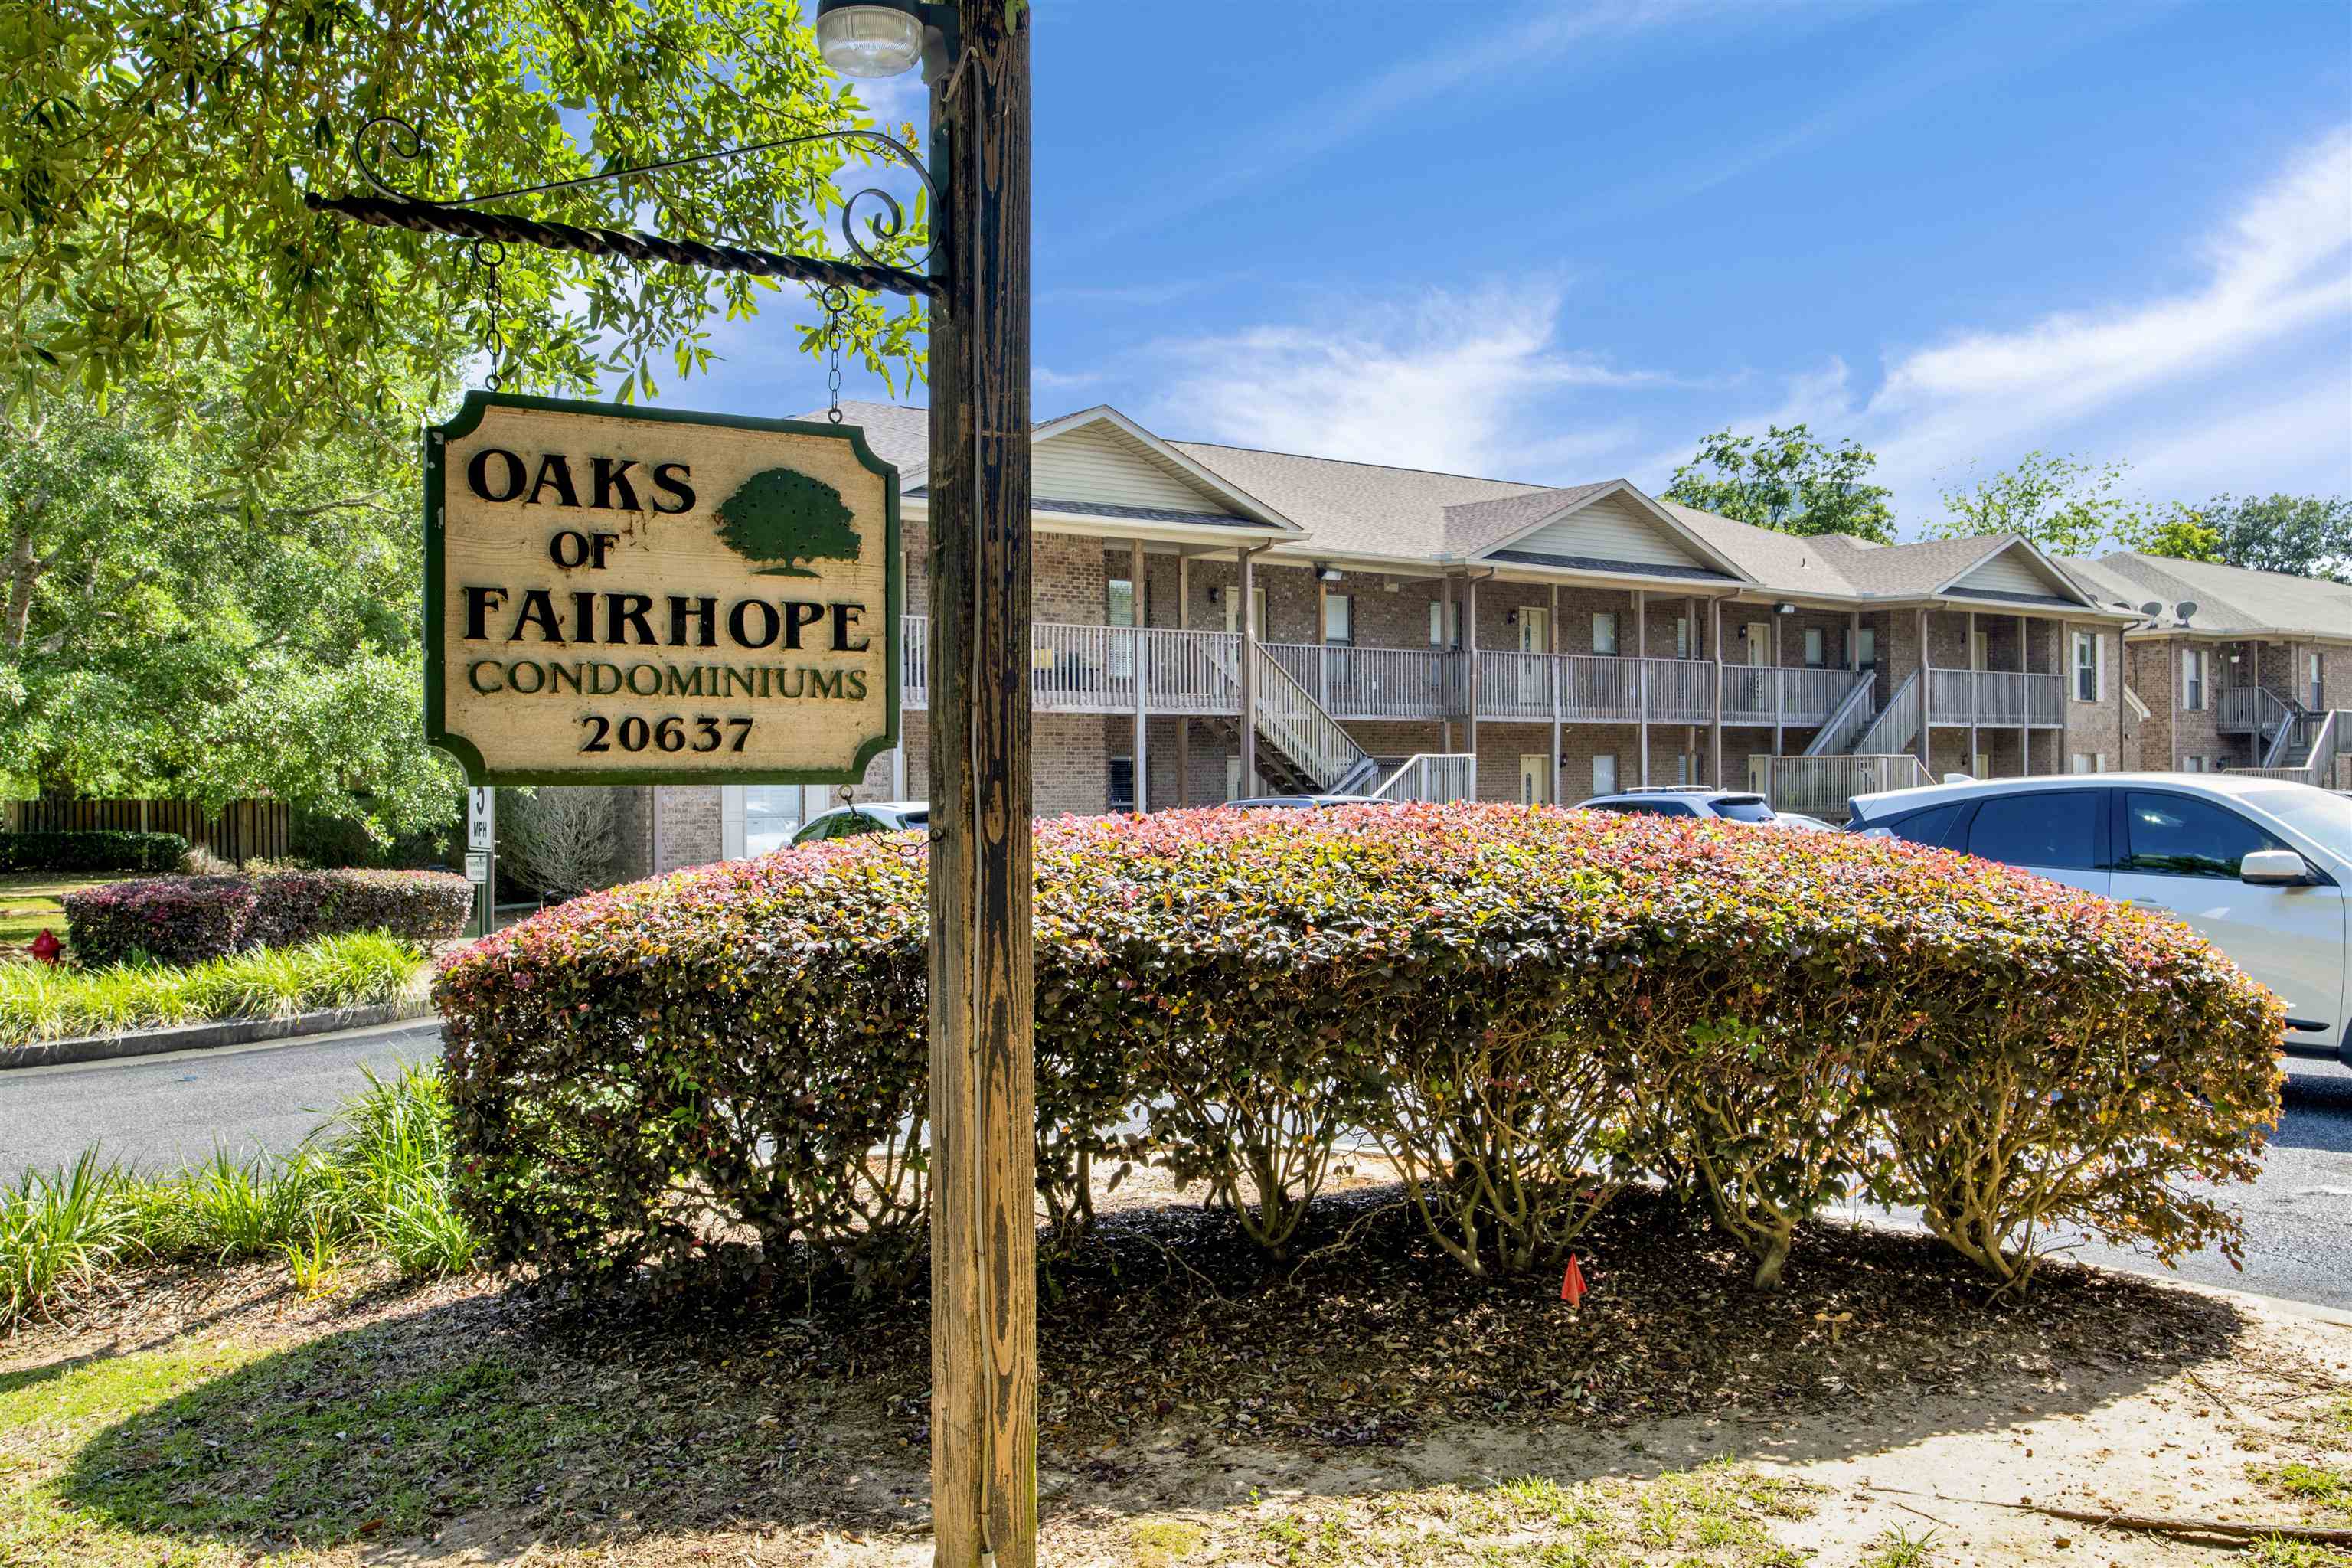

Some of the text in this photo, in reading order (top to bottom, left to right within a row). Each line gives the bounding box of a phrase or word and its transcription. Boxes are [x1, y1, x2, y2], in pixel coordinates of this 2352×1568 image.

[467, 449, 697, 514] OAKS
[550, 531, 620, 570] OF
[463, 586, 871, 652] FAIRHOPE
[469, 660, 867, 701] CONDOMINIUMS
[581, 716, 754, 753] 20637
[473, 821, 488, 838] MPH
